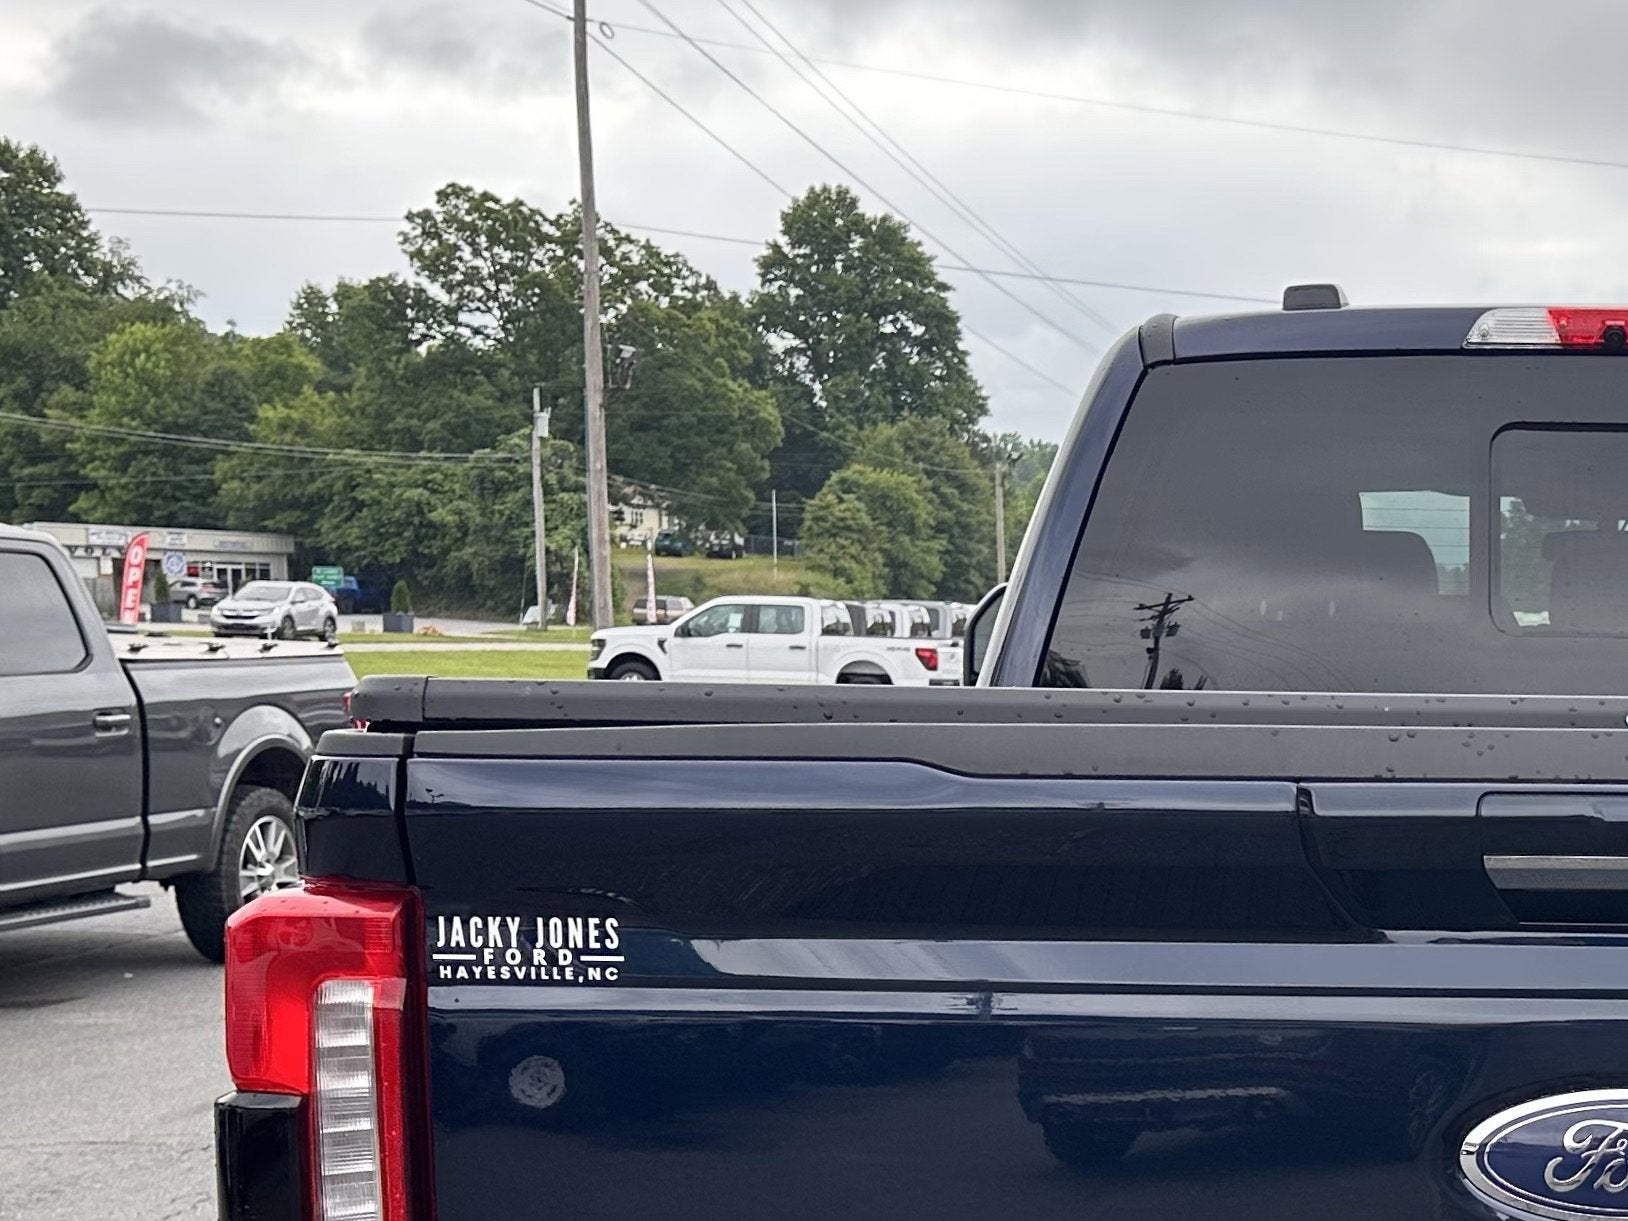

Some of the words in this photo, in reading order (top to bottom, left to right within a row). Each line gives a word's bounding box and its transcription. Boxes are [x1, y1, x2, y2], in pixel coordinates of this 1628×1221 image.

[437, 915, 521, 948] JACKY
[535, 917, 620, 949] JONES
[483, 948, 574, 966] FORD
